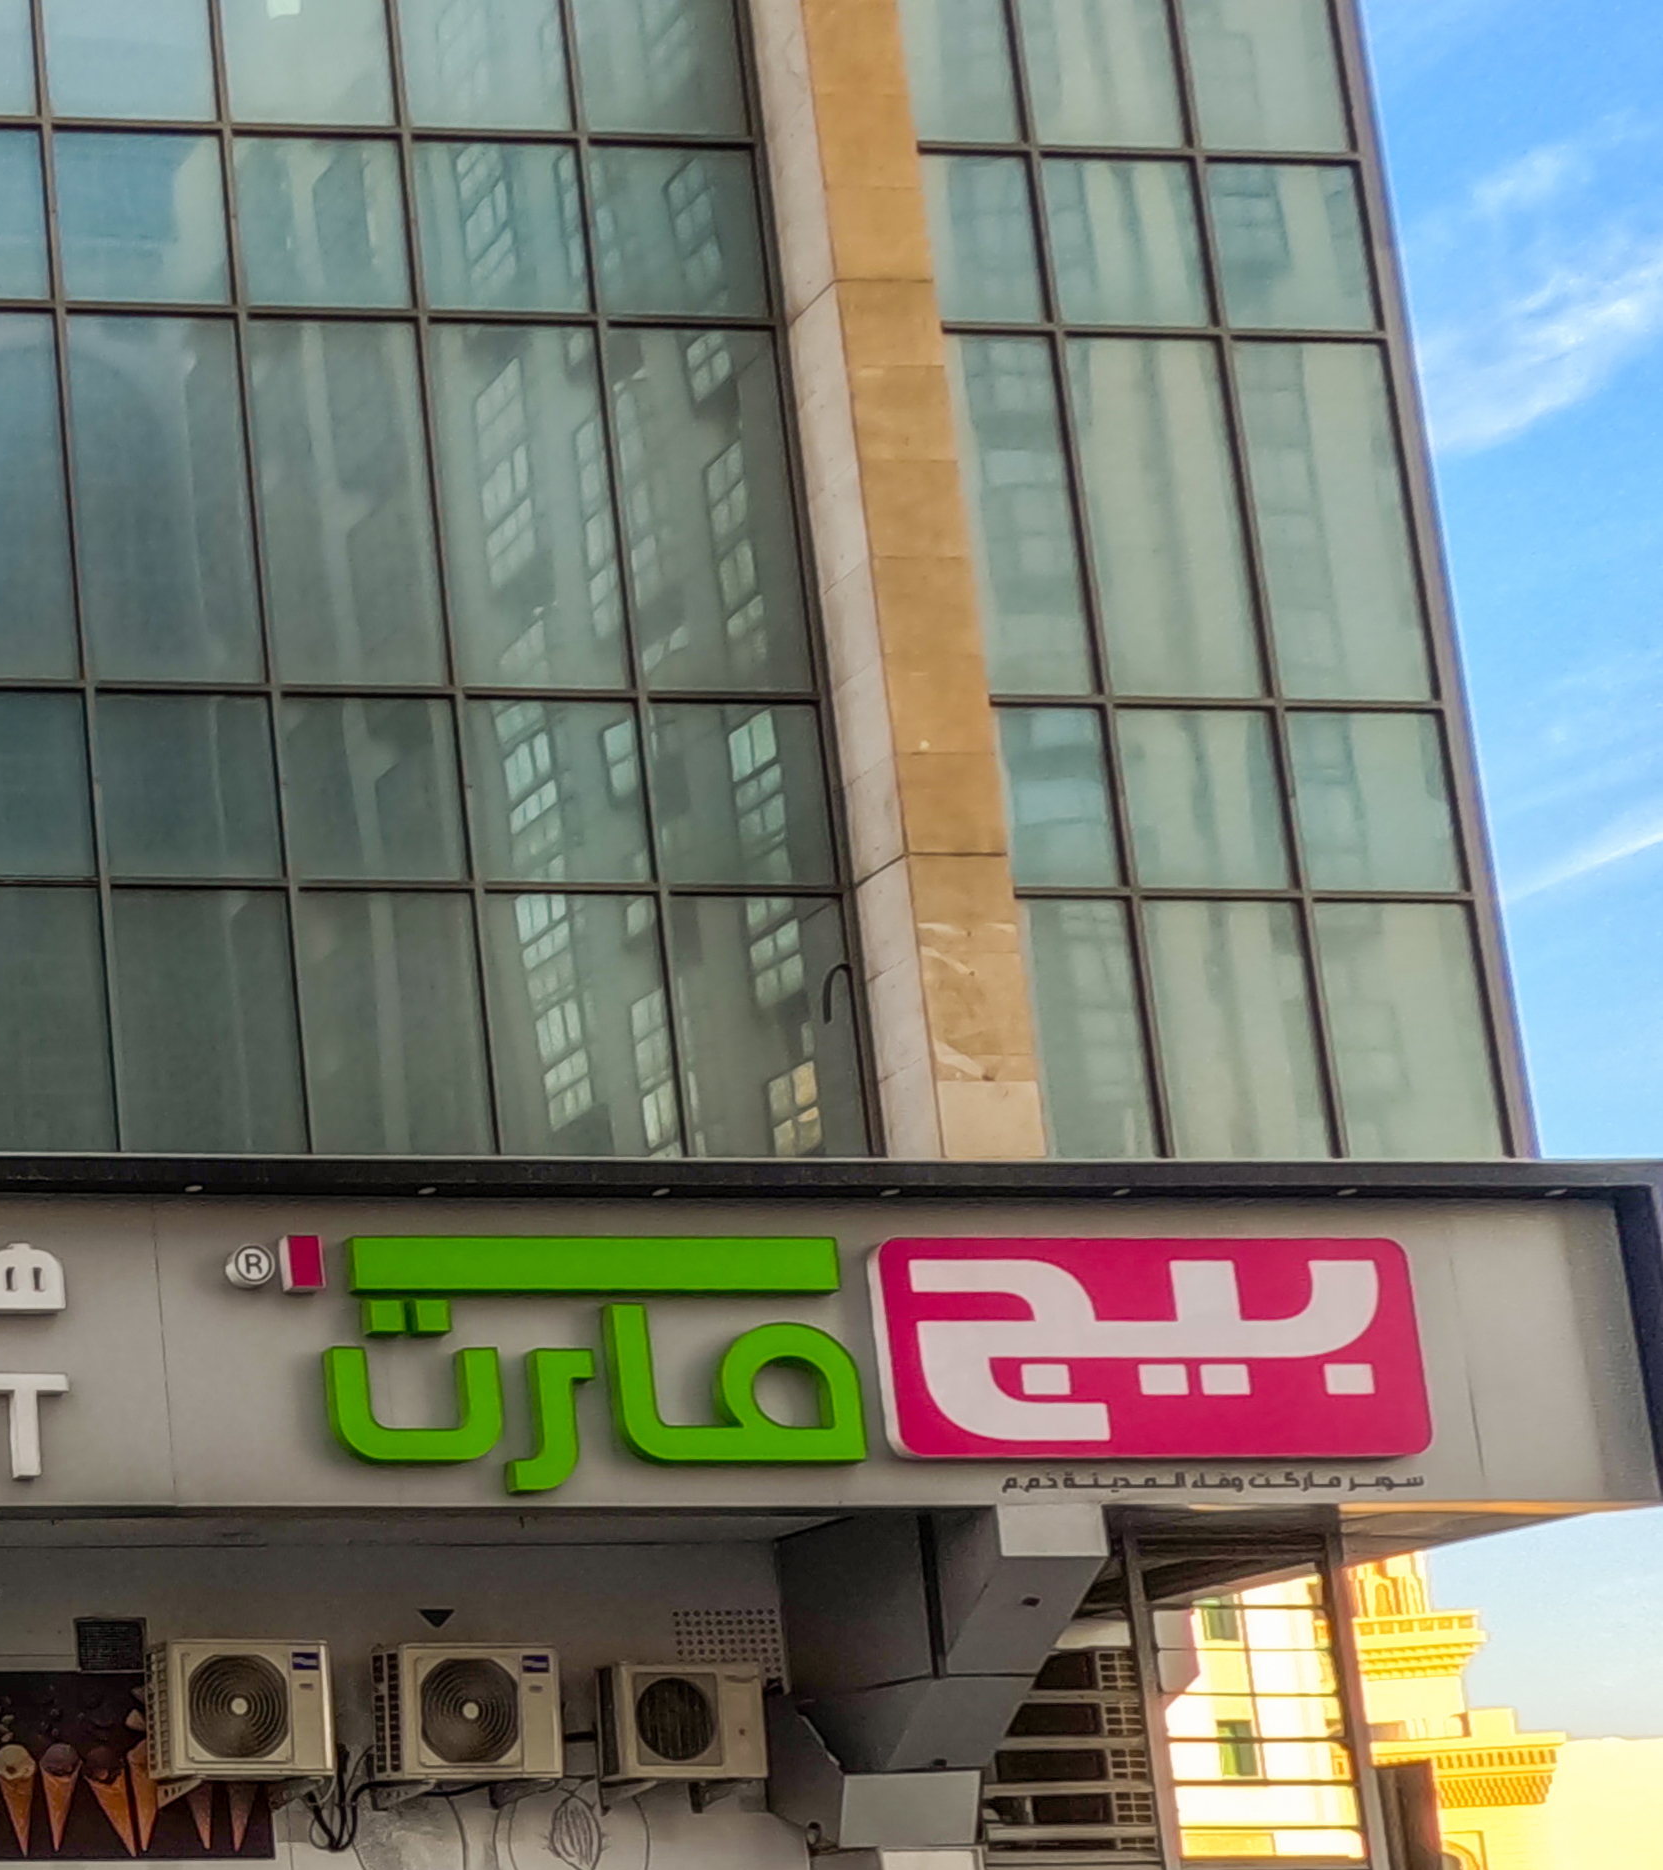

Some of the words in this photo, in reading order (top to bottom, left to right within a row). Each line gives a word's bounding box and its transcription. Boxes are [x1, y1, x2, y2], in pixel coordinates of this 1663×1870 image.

[322, 1299, 867, 1495] مارت
[907, 1259, 1379, 1441] بيج
[1248, 1471, 1342, 1492] ماركت
